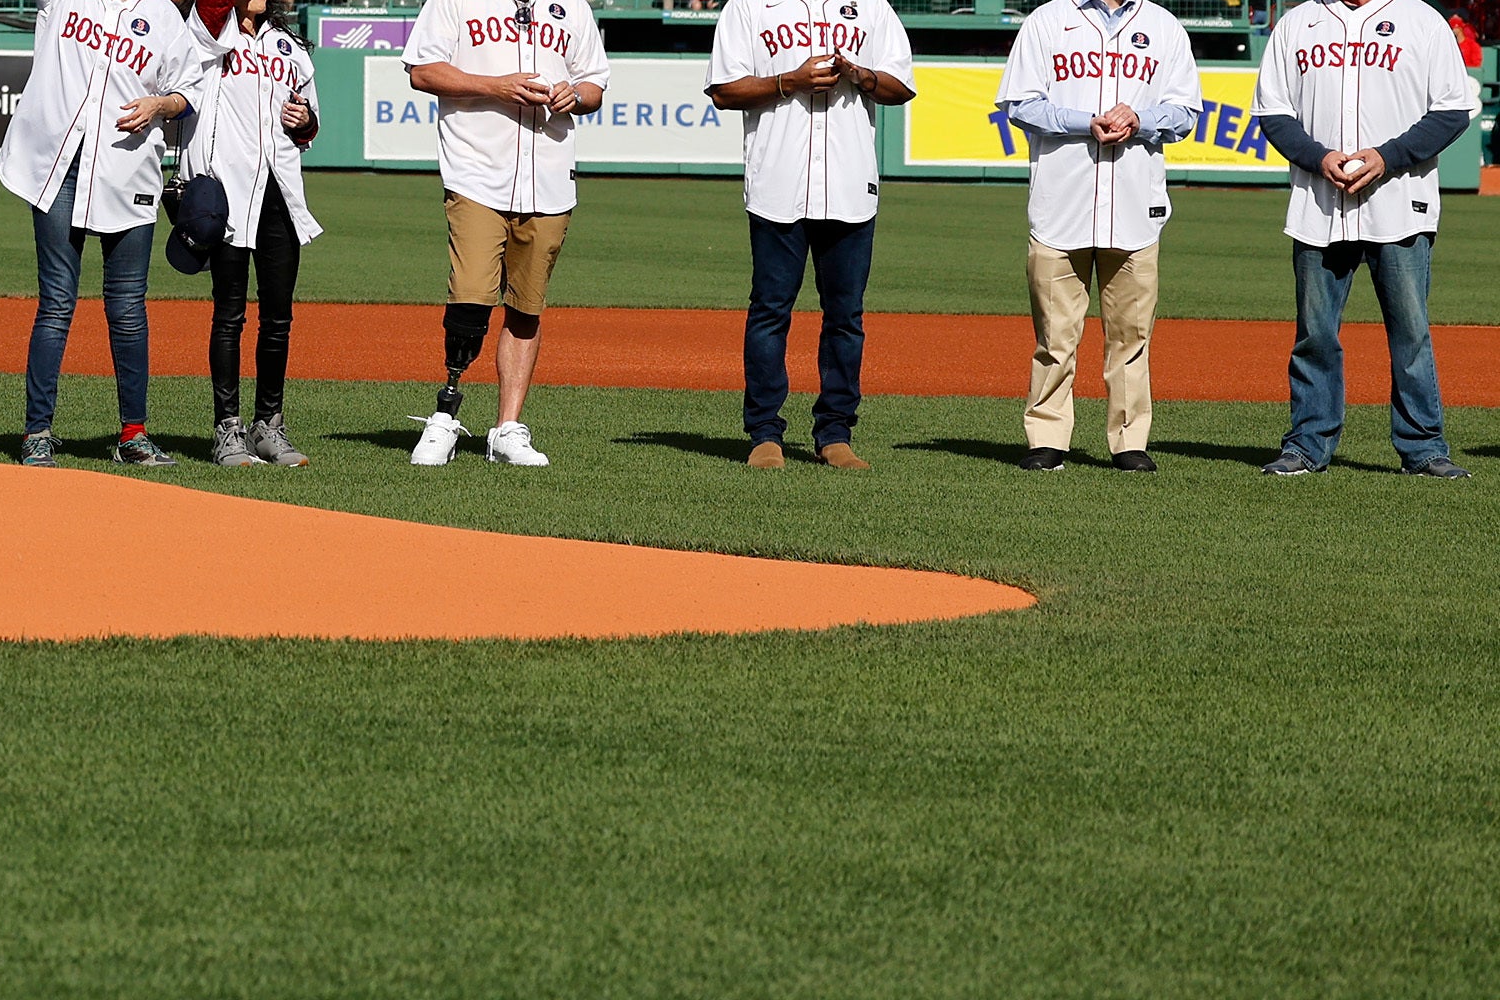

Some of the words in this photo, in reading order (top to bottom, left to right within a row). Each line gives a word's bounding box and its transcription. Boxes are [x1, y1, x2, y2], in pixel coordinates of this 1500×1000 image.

[61, 11, 153, 76] BOSTON
[466, 16, 571, 57] BOSTON
[760, 21, 867, 58] BOSTON
[1052, 51, 1159, 85] BOSTON
[1295, 41, 1402, 76] BOSTON
[578, 103, 721, 128] MERICA
[1195, 99, 1268, 162] TEA
